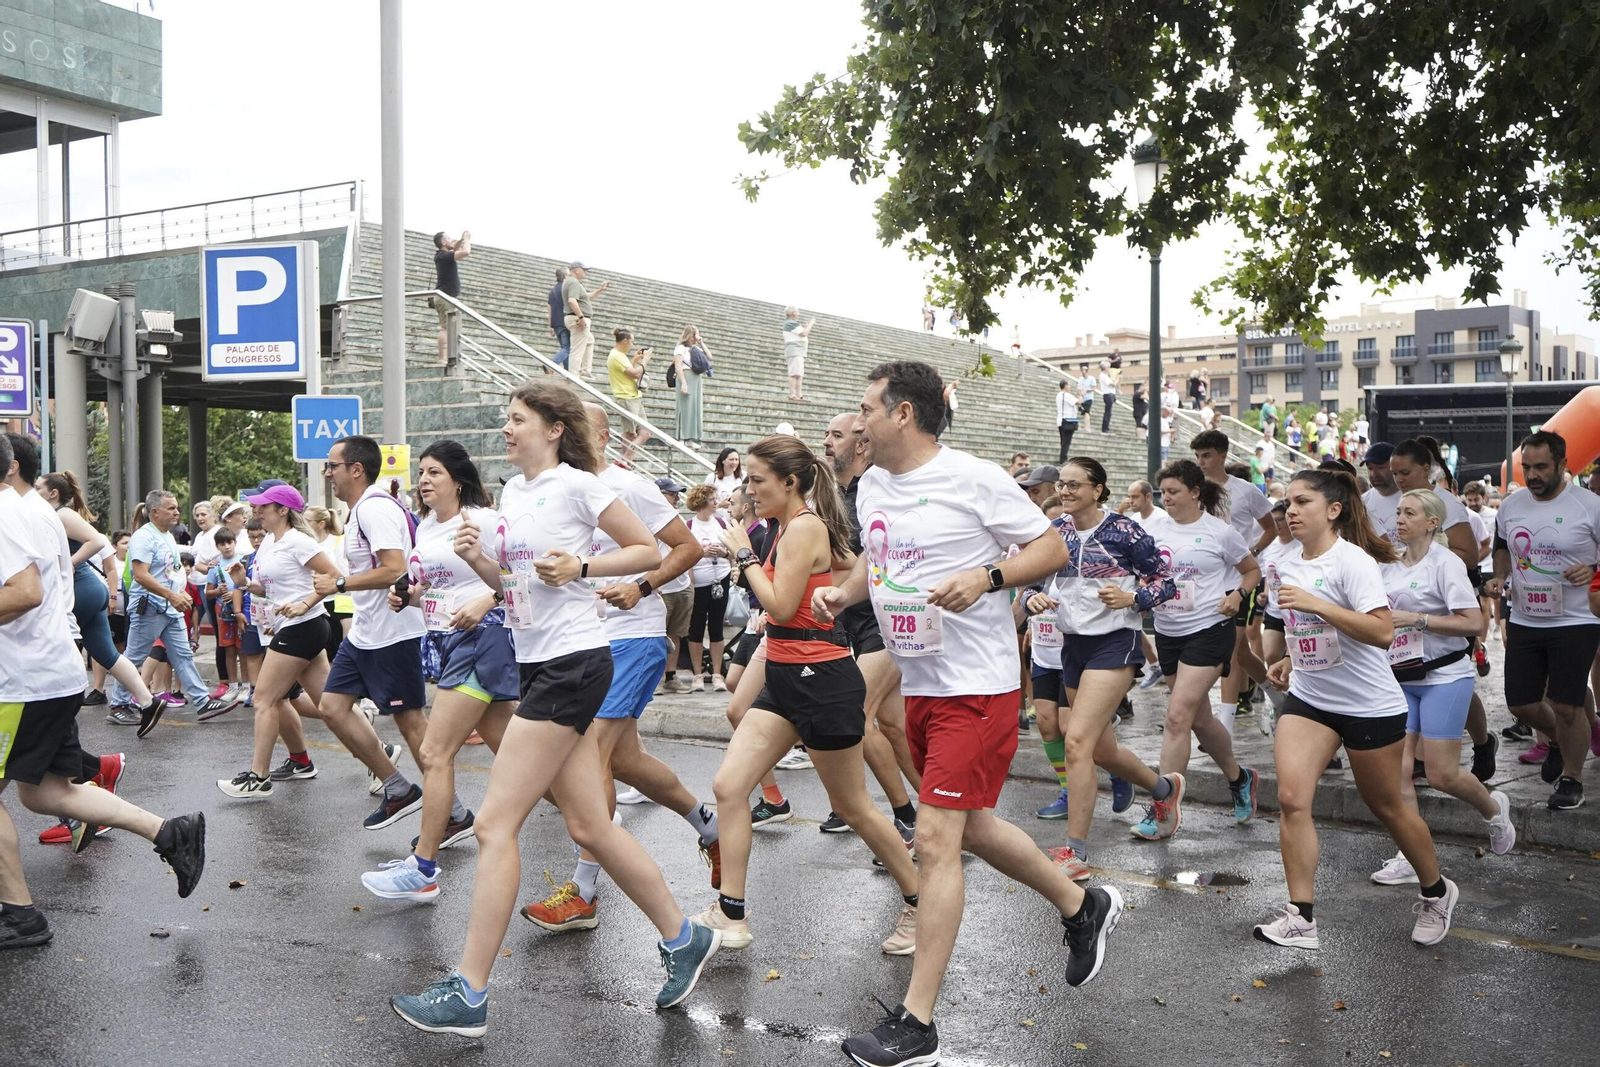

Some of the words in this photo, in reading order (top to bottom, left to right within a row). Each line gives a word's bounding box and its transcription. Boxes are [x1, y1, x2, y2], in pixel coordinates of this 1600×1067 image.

[216, 255, 287, 335] P
[1325, 322, 1363, 334] HOTEL
[226, 344, 265, 354] PALACIO
[267, 344, 280, 352] DE
[225, 354, 282, 364] CONGRESOS
[297, 419, 358, 439] TAXI
[1527, 592, 1548, 604] 388
[425, 600, 437, 614] 727
[883, 604, 926, 612] COVIRAN
[890, 614, 917, 633] 728
[1039, 622, 1053, 634] 913
[896, 641, 926, 651] vithas
[1298, 637, 1317, 653] 137
[1395, 650, 1412, 659] vithas
[1305, 658, 1328, 666] vithas
